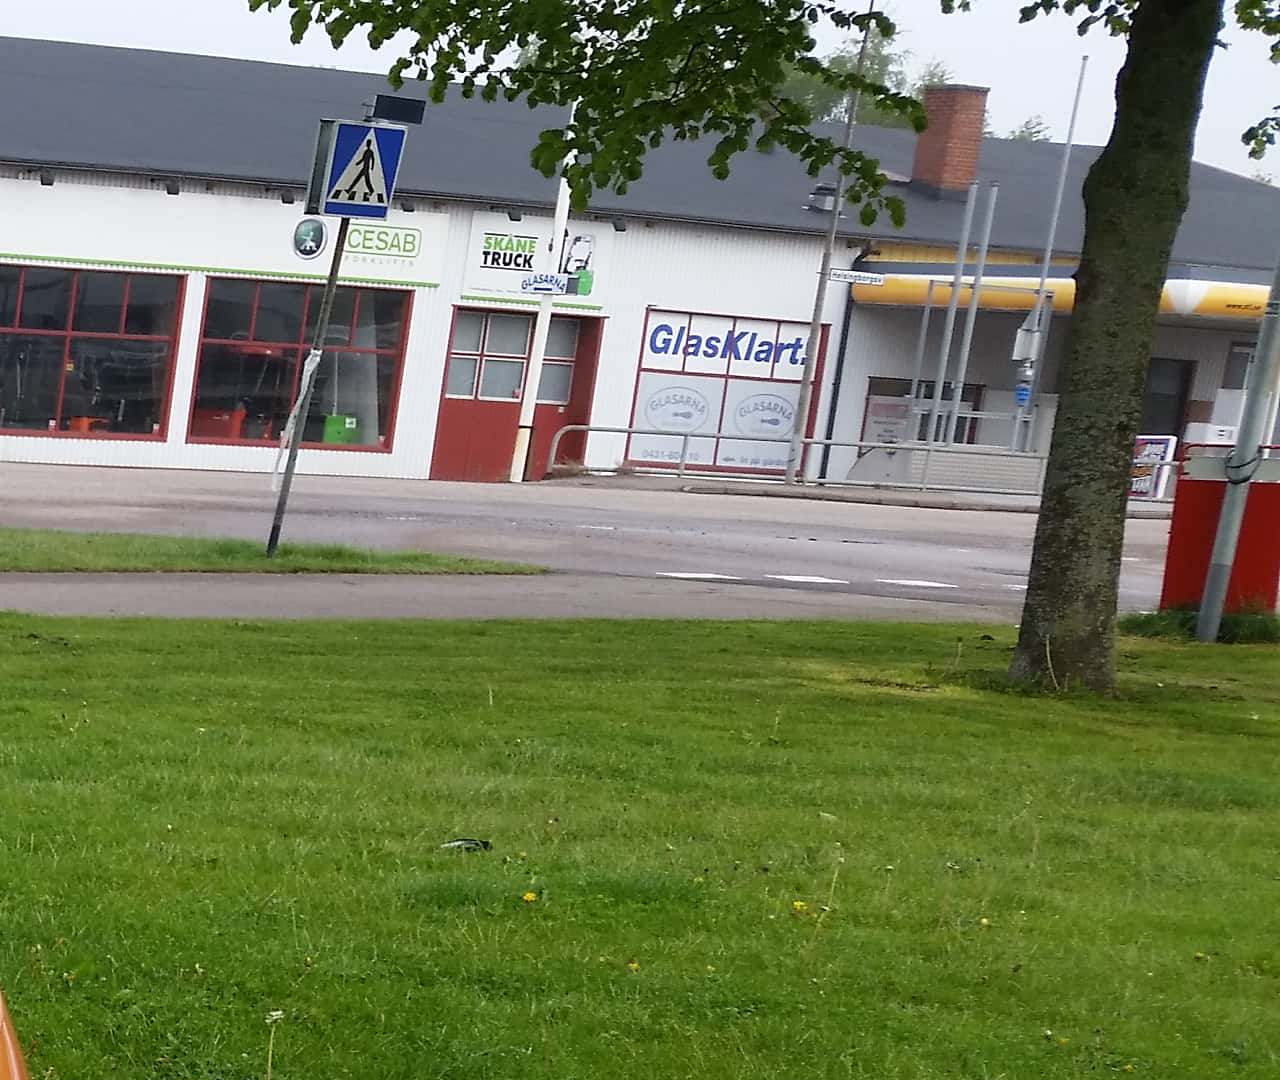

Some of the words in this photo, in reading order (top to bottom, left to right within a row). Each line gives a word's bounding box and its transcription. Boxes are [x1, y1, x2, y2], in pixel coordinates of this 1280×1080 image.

[347, 228, 417, 253] CESAB
[483, 234, 537, 253] SKÅNE
[482, 250, 535, 268] TRUCK
[521, 273, 567, 293] GLASARNA
[650, 393, 706, 416] GLASARNA
[740, 401, 793, 421] GLASARNA
